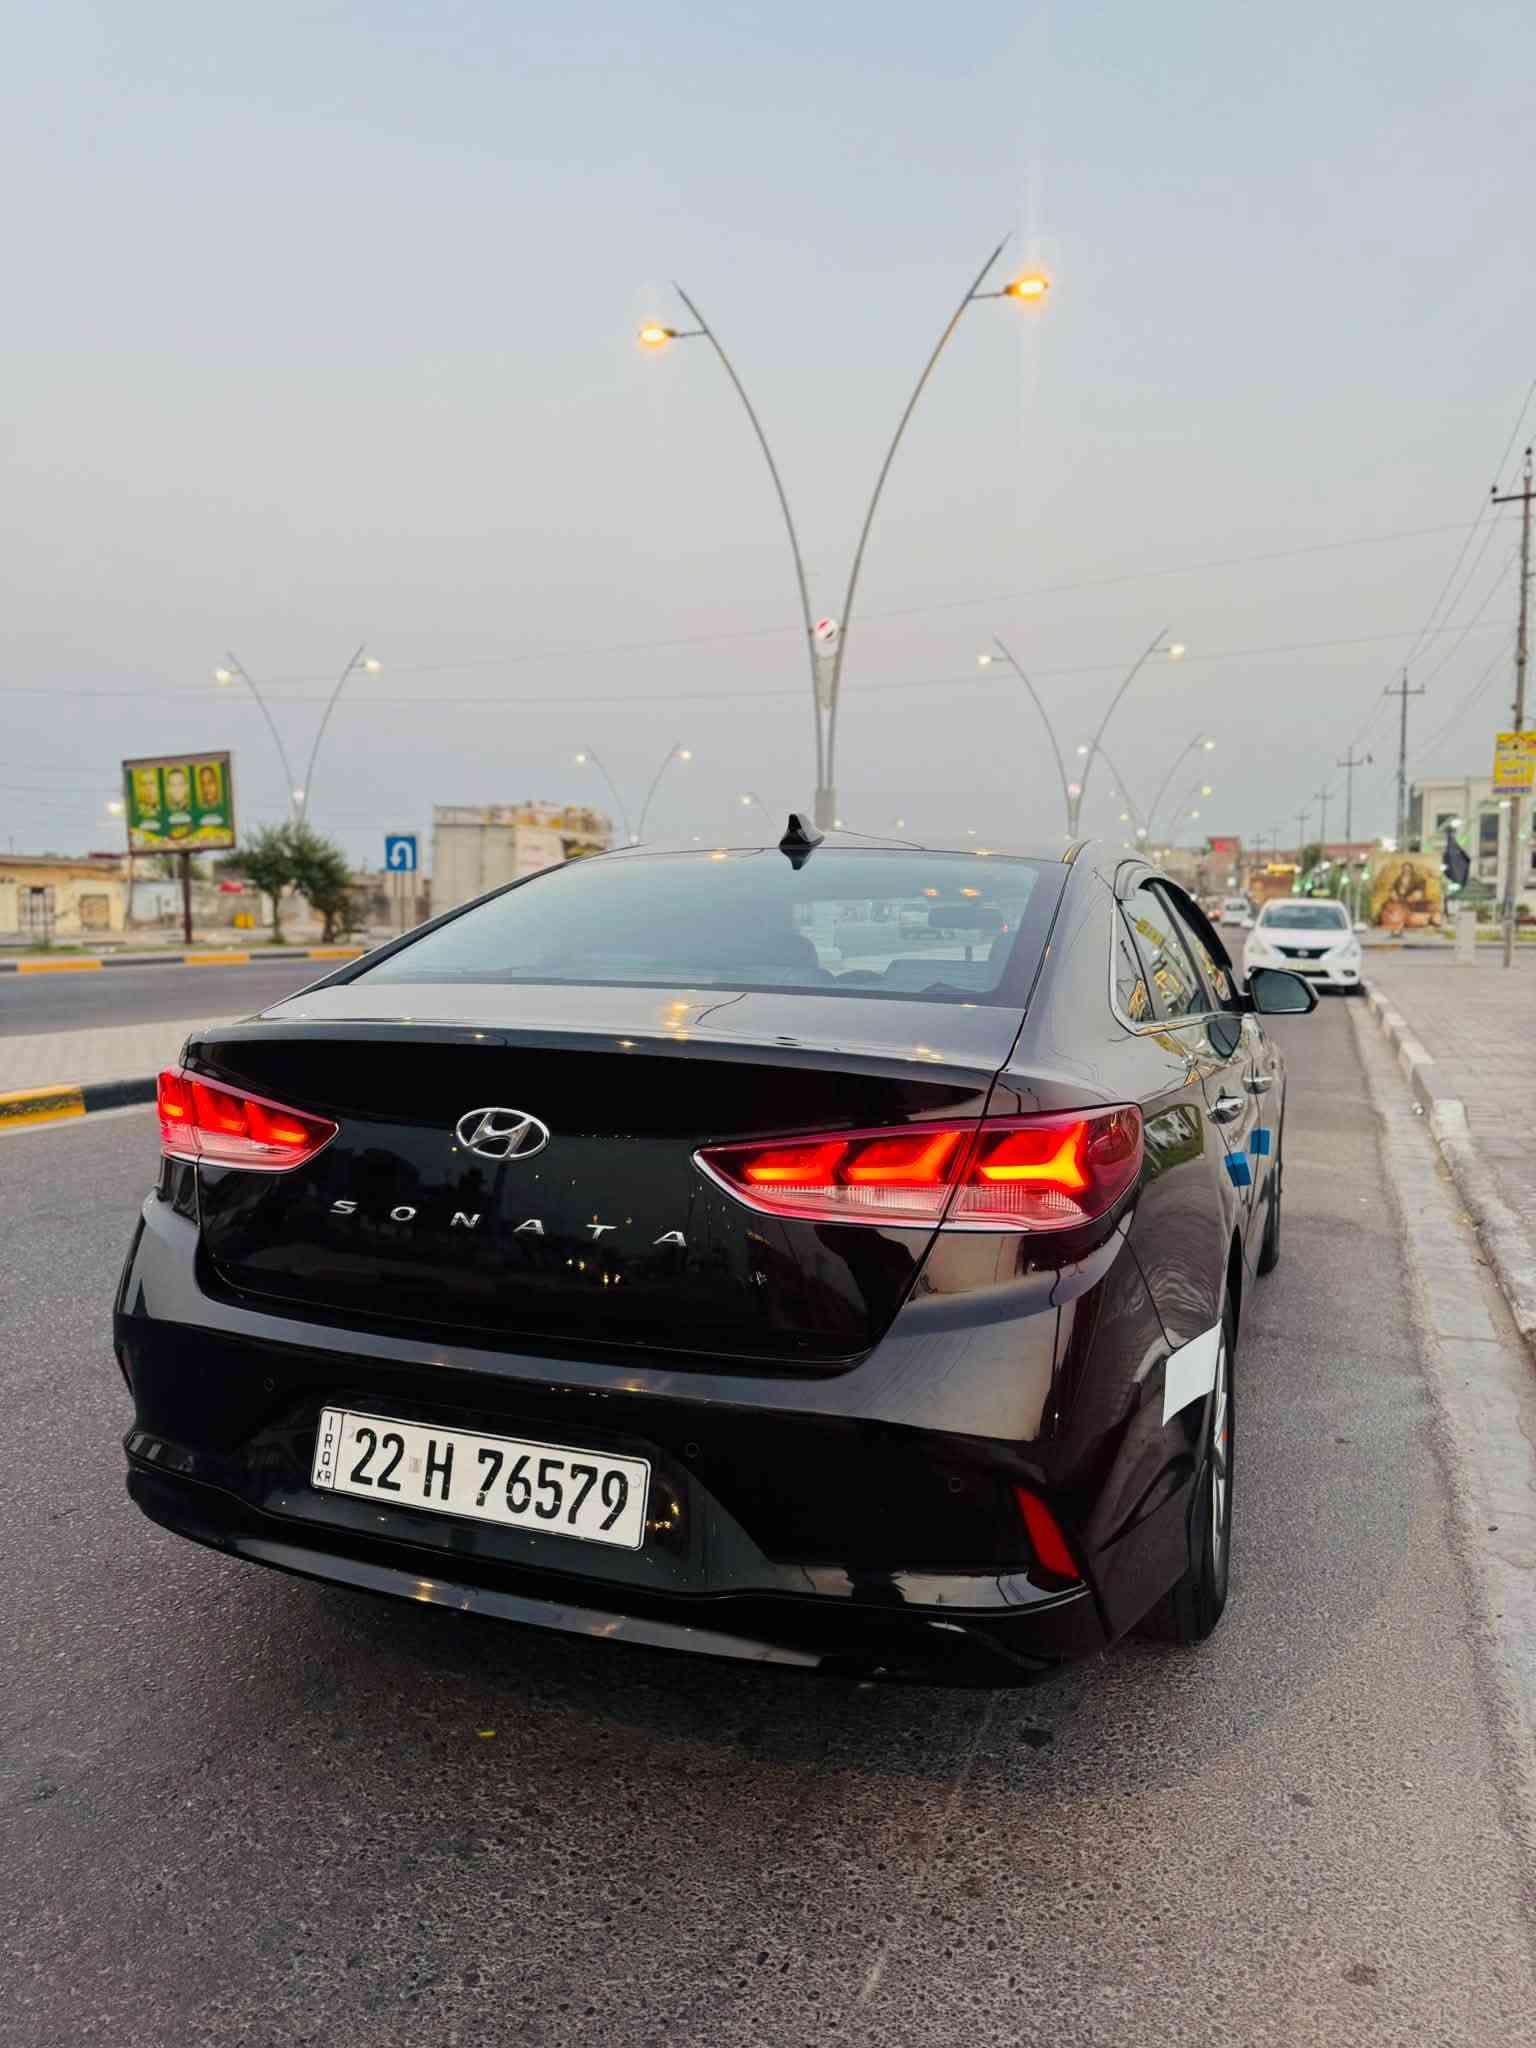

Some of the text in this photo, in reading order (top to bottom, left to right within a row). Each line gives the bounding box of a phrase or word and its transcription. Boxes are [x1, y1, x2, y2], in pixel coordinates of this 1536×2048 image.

[329, 1200, 687, 1247] SONATA
[350, 1427, 629, 1531] 22 H 76579
